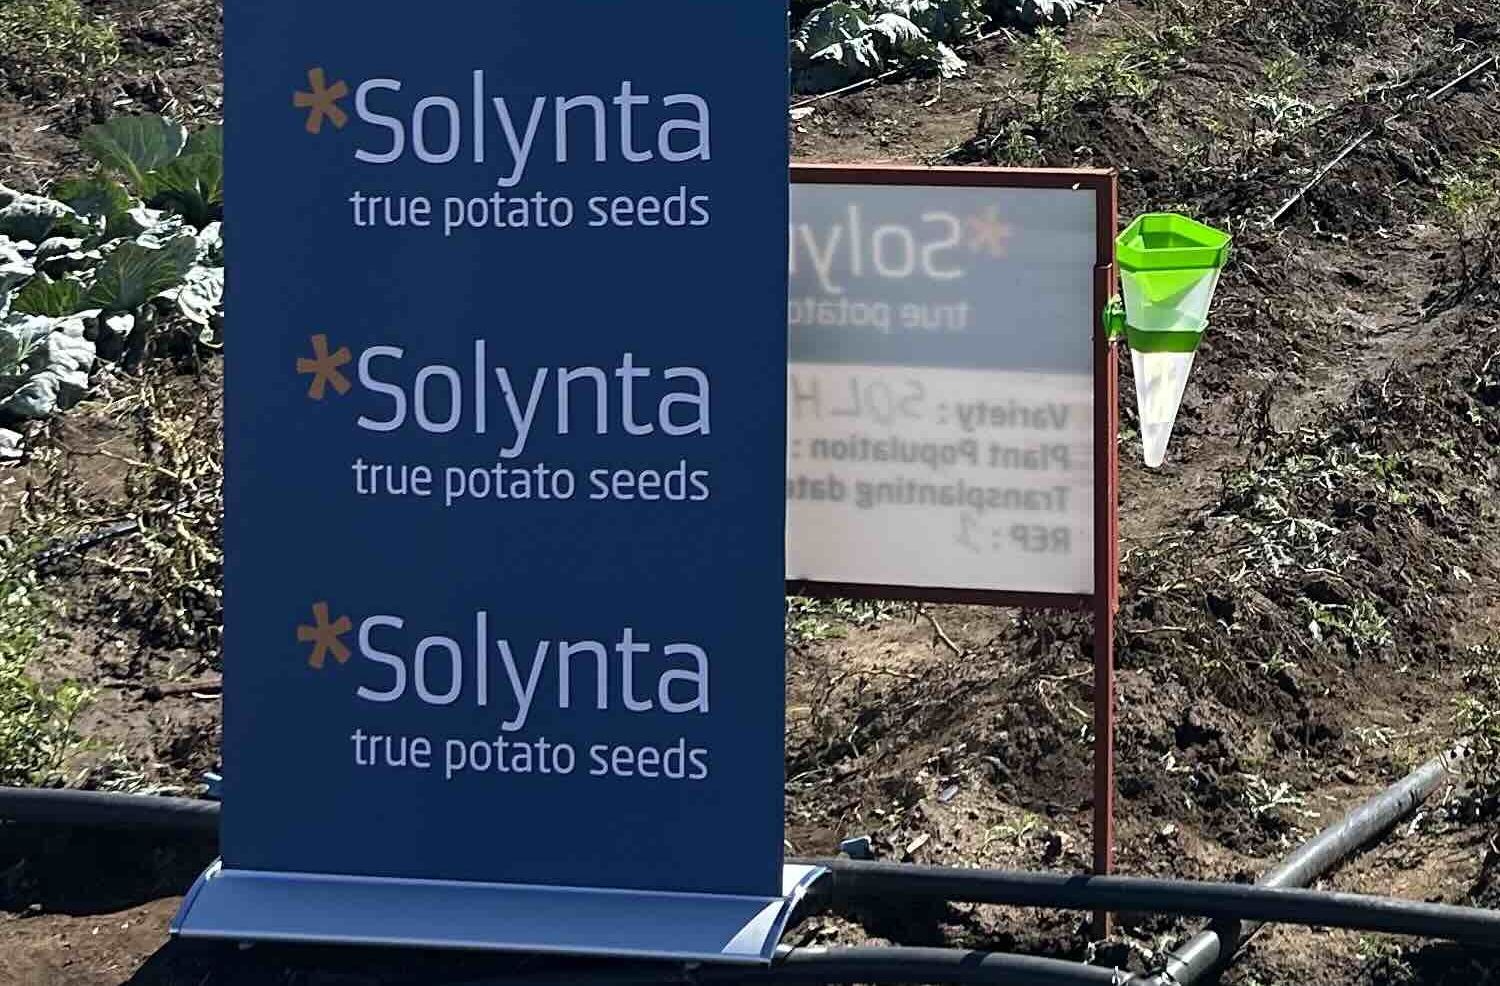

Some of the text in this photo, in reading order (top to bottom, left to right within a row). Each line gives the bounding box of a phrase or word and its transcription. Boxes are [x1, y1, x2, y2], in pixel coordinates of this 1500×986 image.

[354, 69, 711, 188] Solynta
[349, 185, 709, 236] true potato seeds
[357, 339, 711, 459] Solynta
[351, 458, 709, 506] true potato seeds
[357, 611, 710, 732] Solynta
[351, 729, 708, 780] true potato seeds
